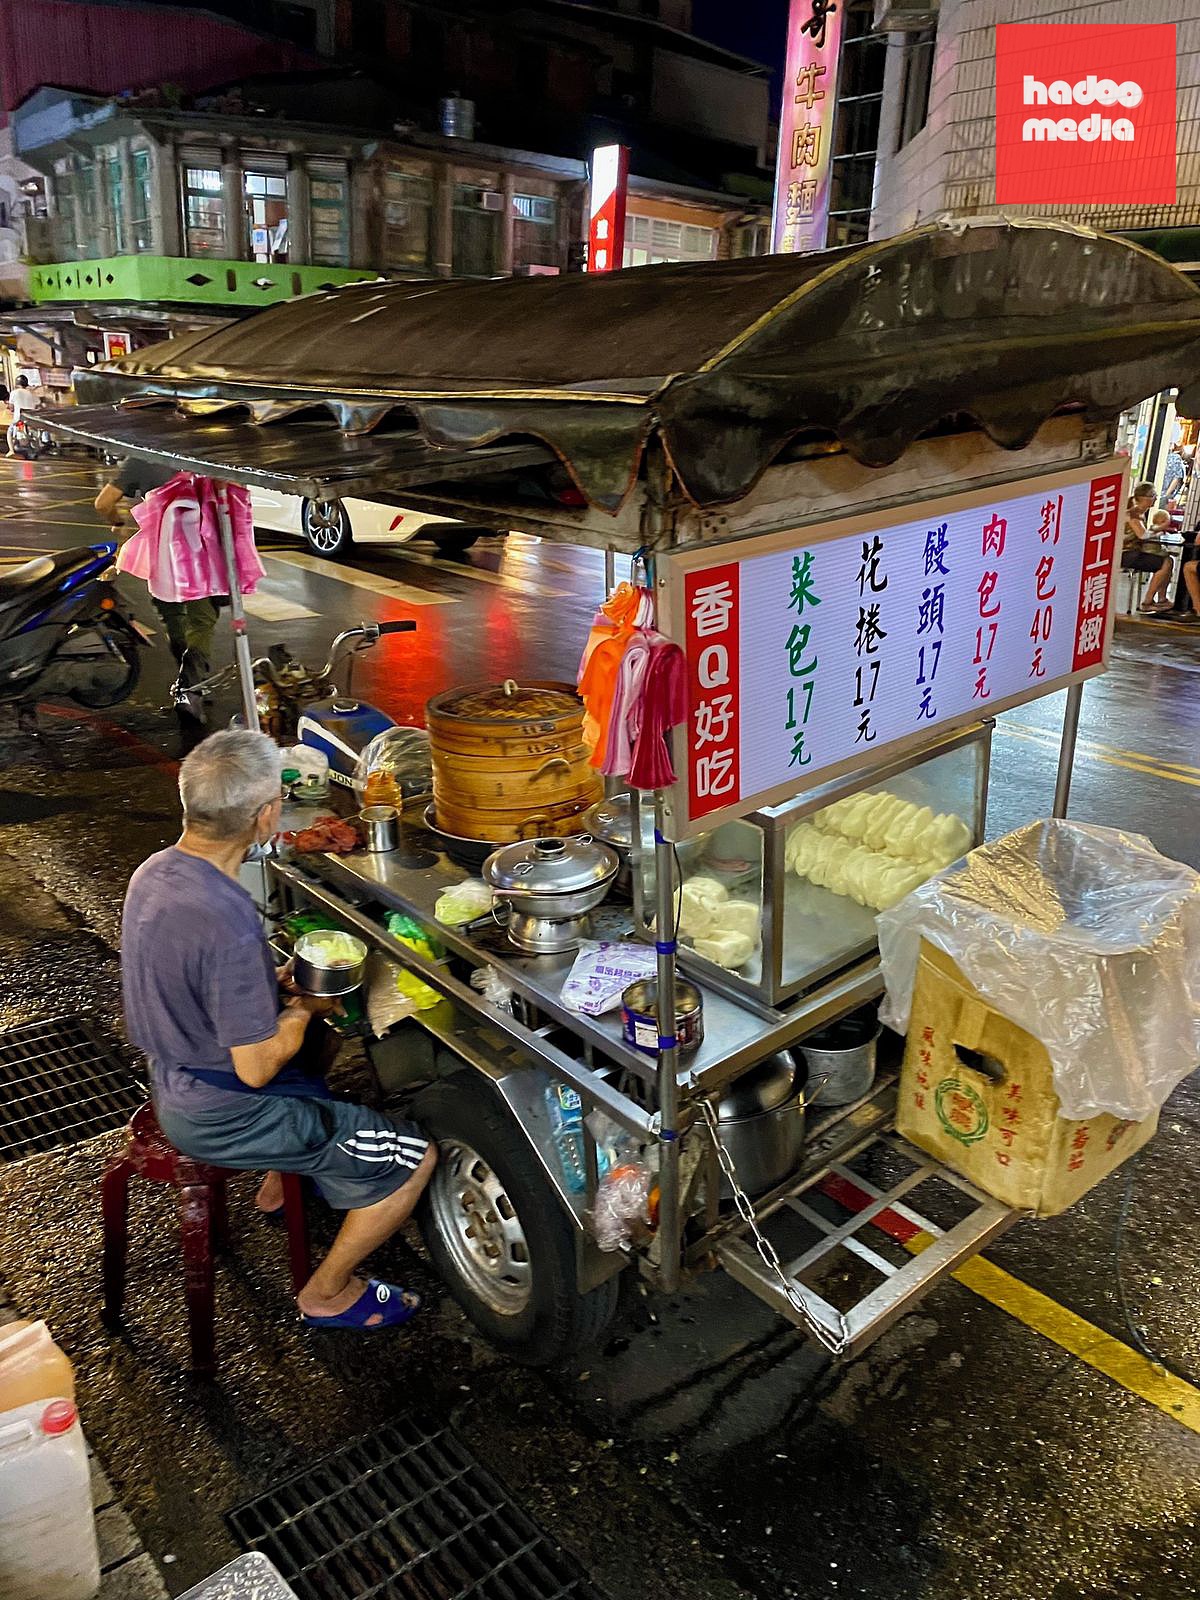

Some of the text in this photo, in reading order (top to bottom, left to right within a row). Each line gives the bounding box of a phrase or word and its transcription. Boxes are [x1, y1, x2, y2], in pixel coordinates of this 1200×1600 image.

[784, 551, 822, 768] 菜包17元
[915, 522, 951, 722] 饅頭17元
[971, 512, 1008, 701] 肉包17元
[1028, 494, 1064, 678] 割包40元
[1076, 484, 1117, 657] 手工精緻
[690, 580, 736, 800] 香Q好吃
